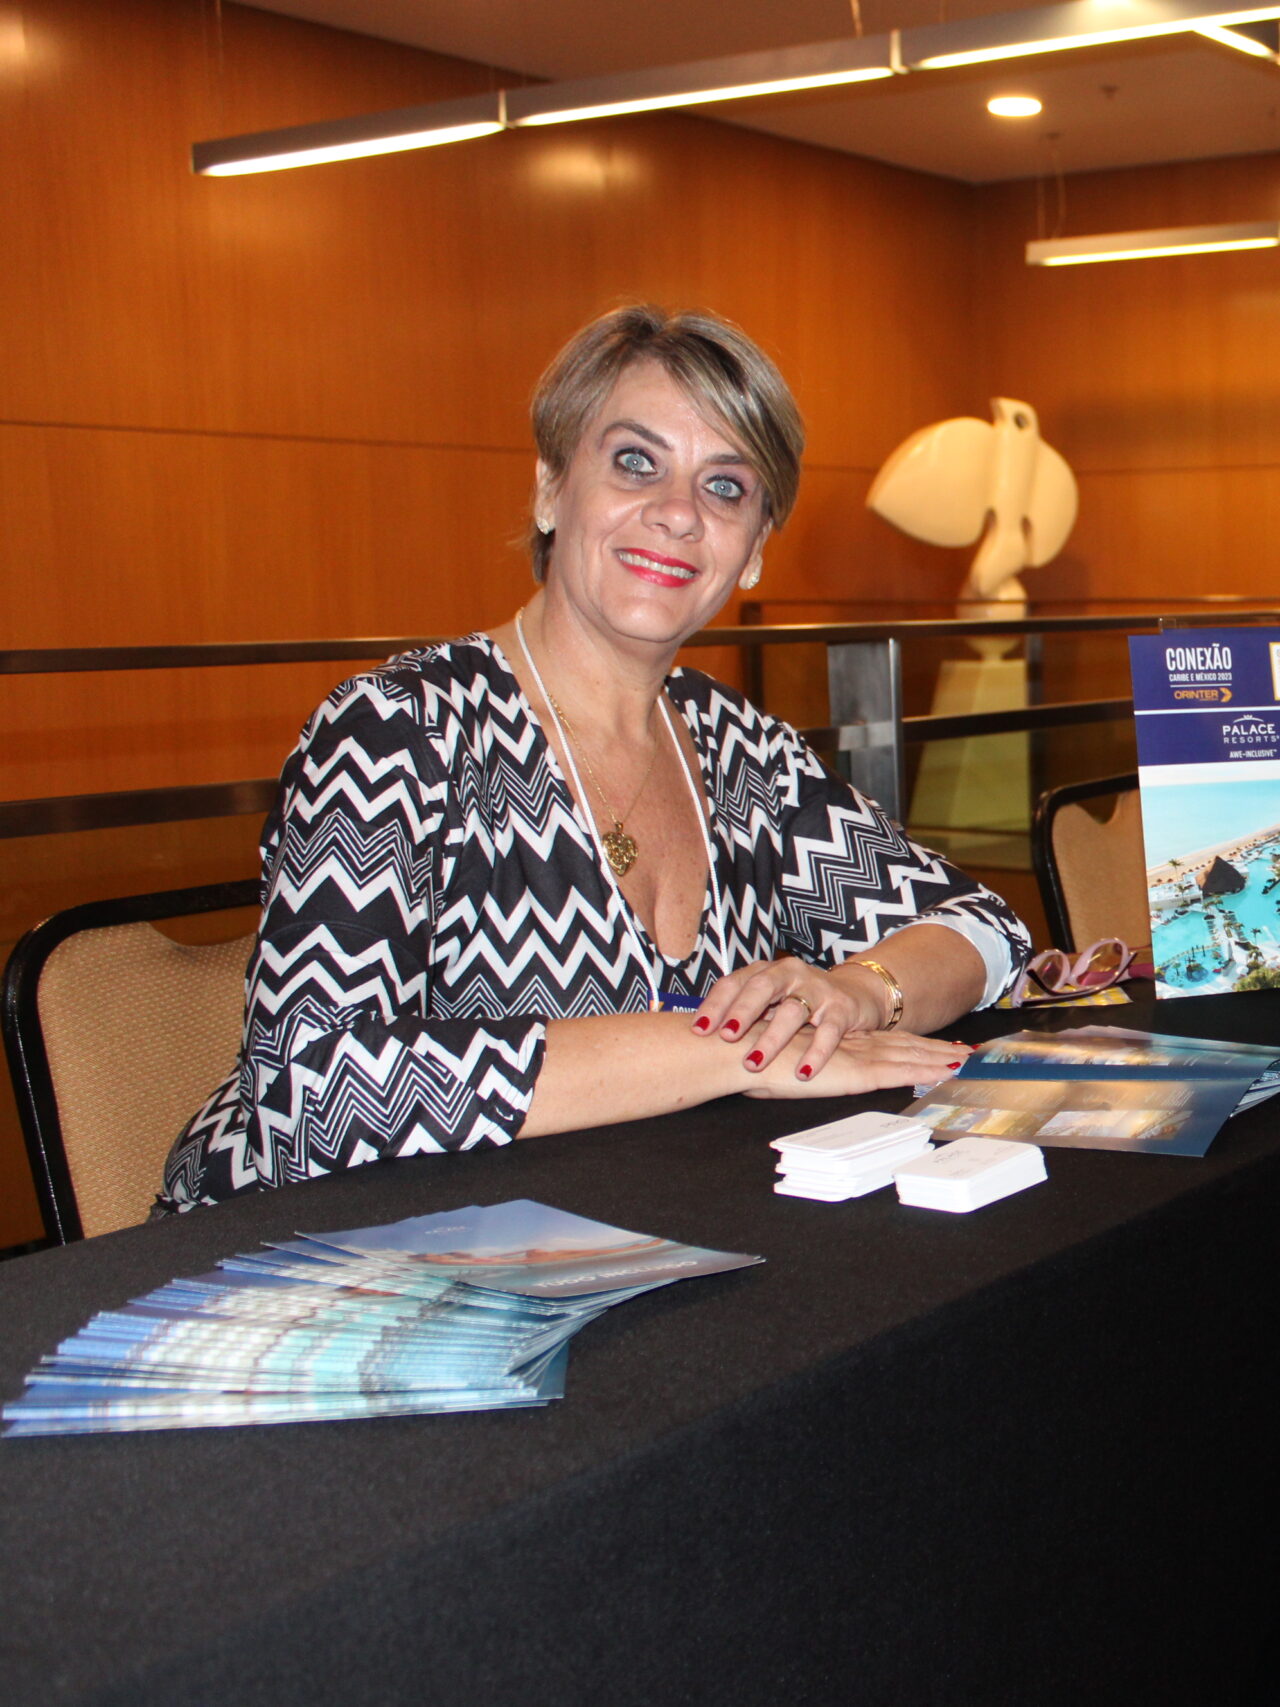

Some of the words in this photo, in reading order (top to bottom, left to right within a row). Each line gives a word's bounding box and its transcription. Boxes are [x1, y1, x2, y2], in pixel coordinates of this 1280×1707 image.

[1166, 643, 1232, 671] CONEXÃO
[1169, 674, 1189, 682] CARIBE
[1174, 689, 1219, 700] ORINTER
[1222, 724, 1276, 735] PALACE
